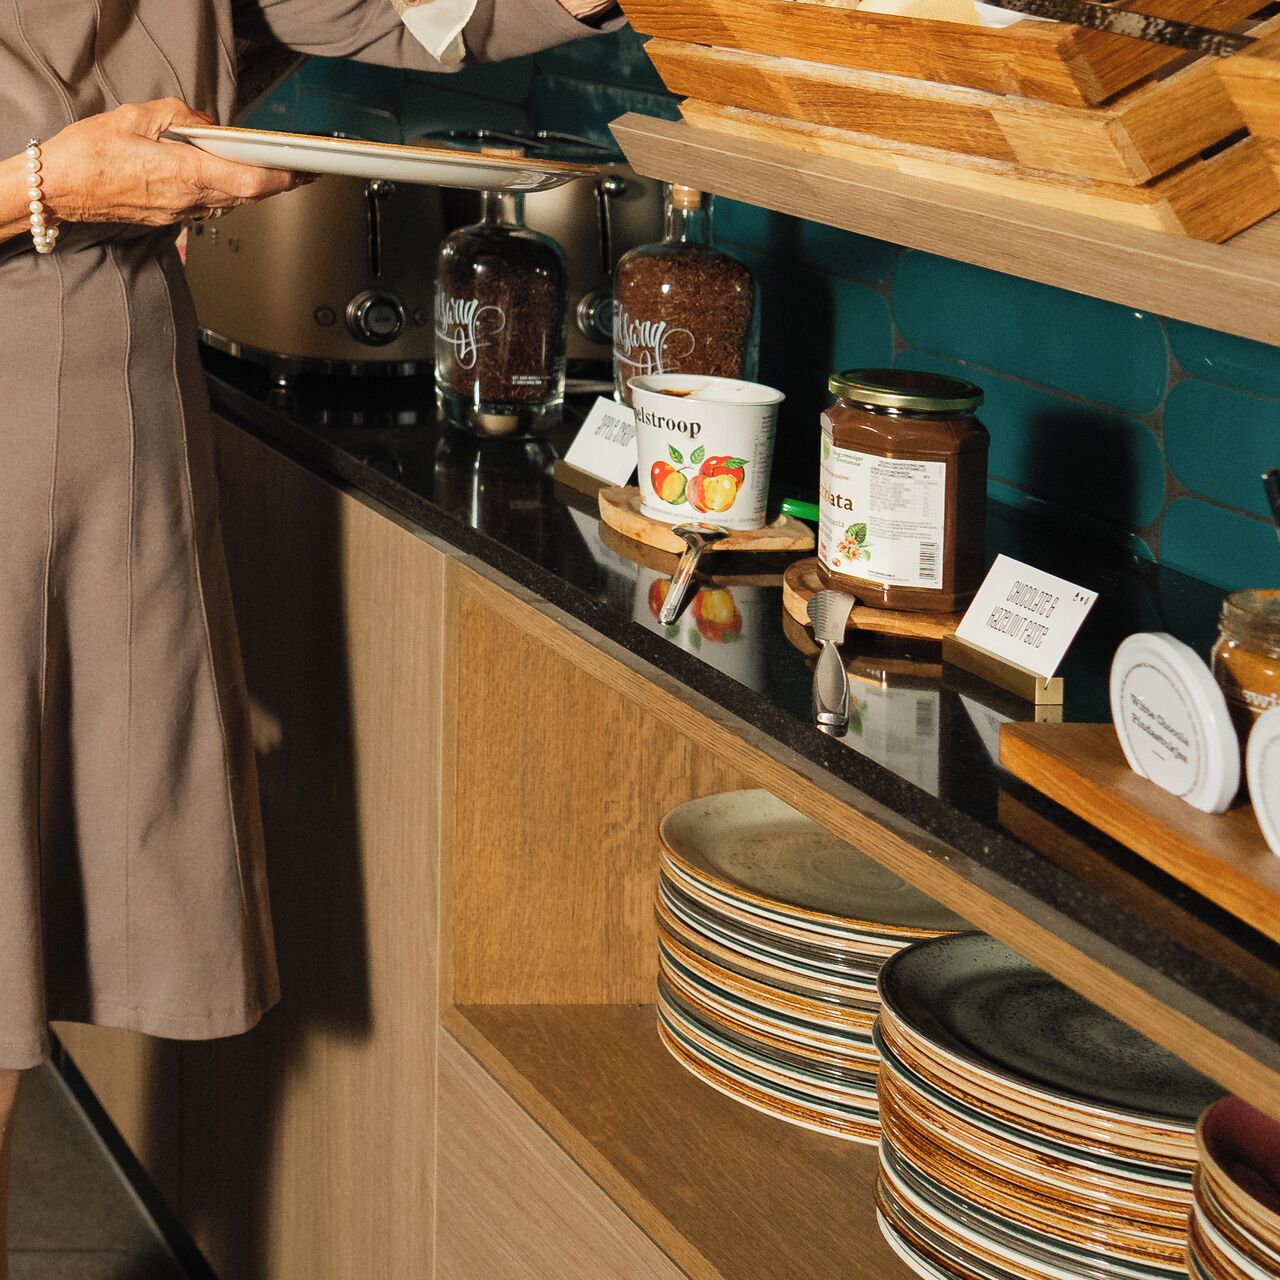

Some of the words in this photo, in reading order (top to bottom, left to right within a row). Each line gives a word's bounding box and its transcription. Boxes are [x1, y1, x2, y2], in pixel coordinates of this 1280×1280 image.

[1006, 580, 1053, 616] CHOCOLATE
[1046, 597, 1059, 618] &
[986, 606, 1027, 639] HAZELNUT
[1020, 620, 1049, 649] PASTE
